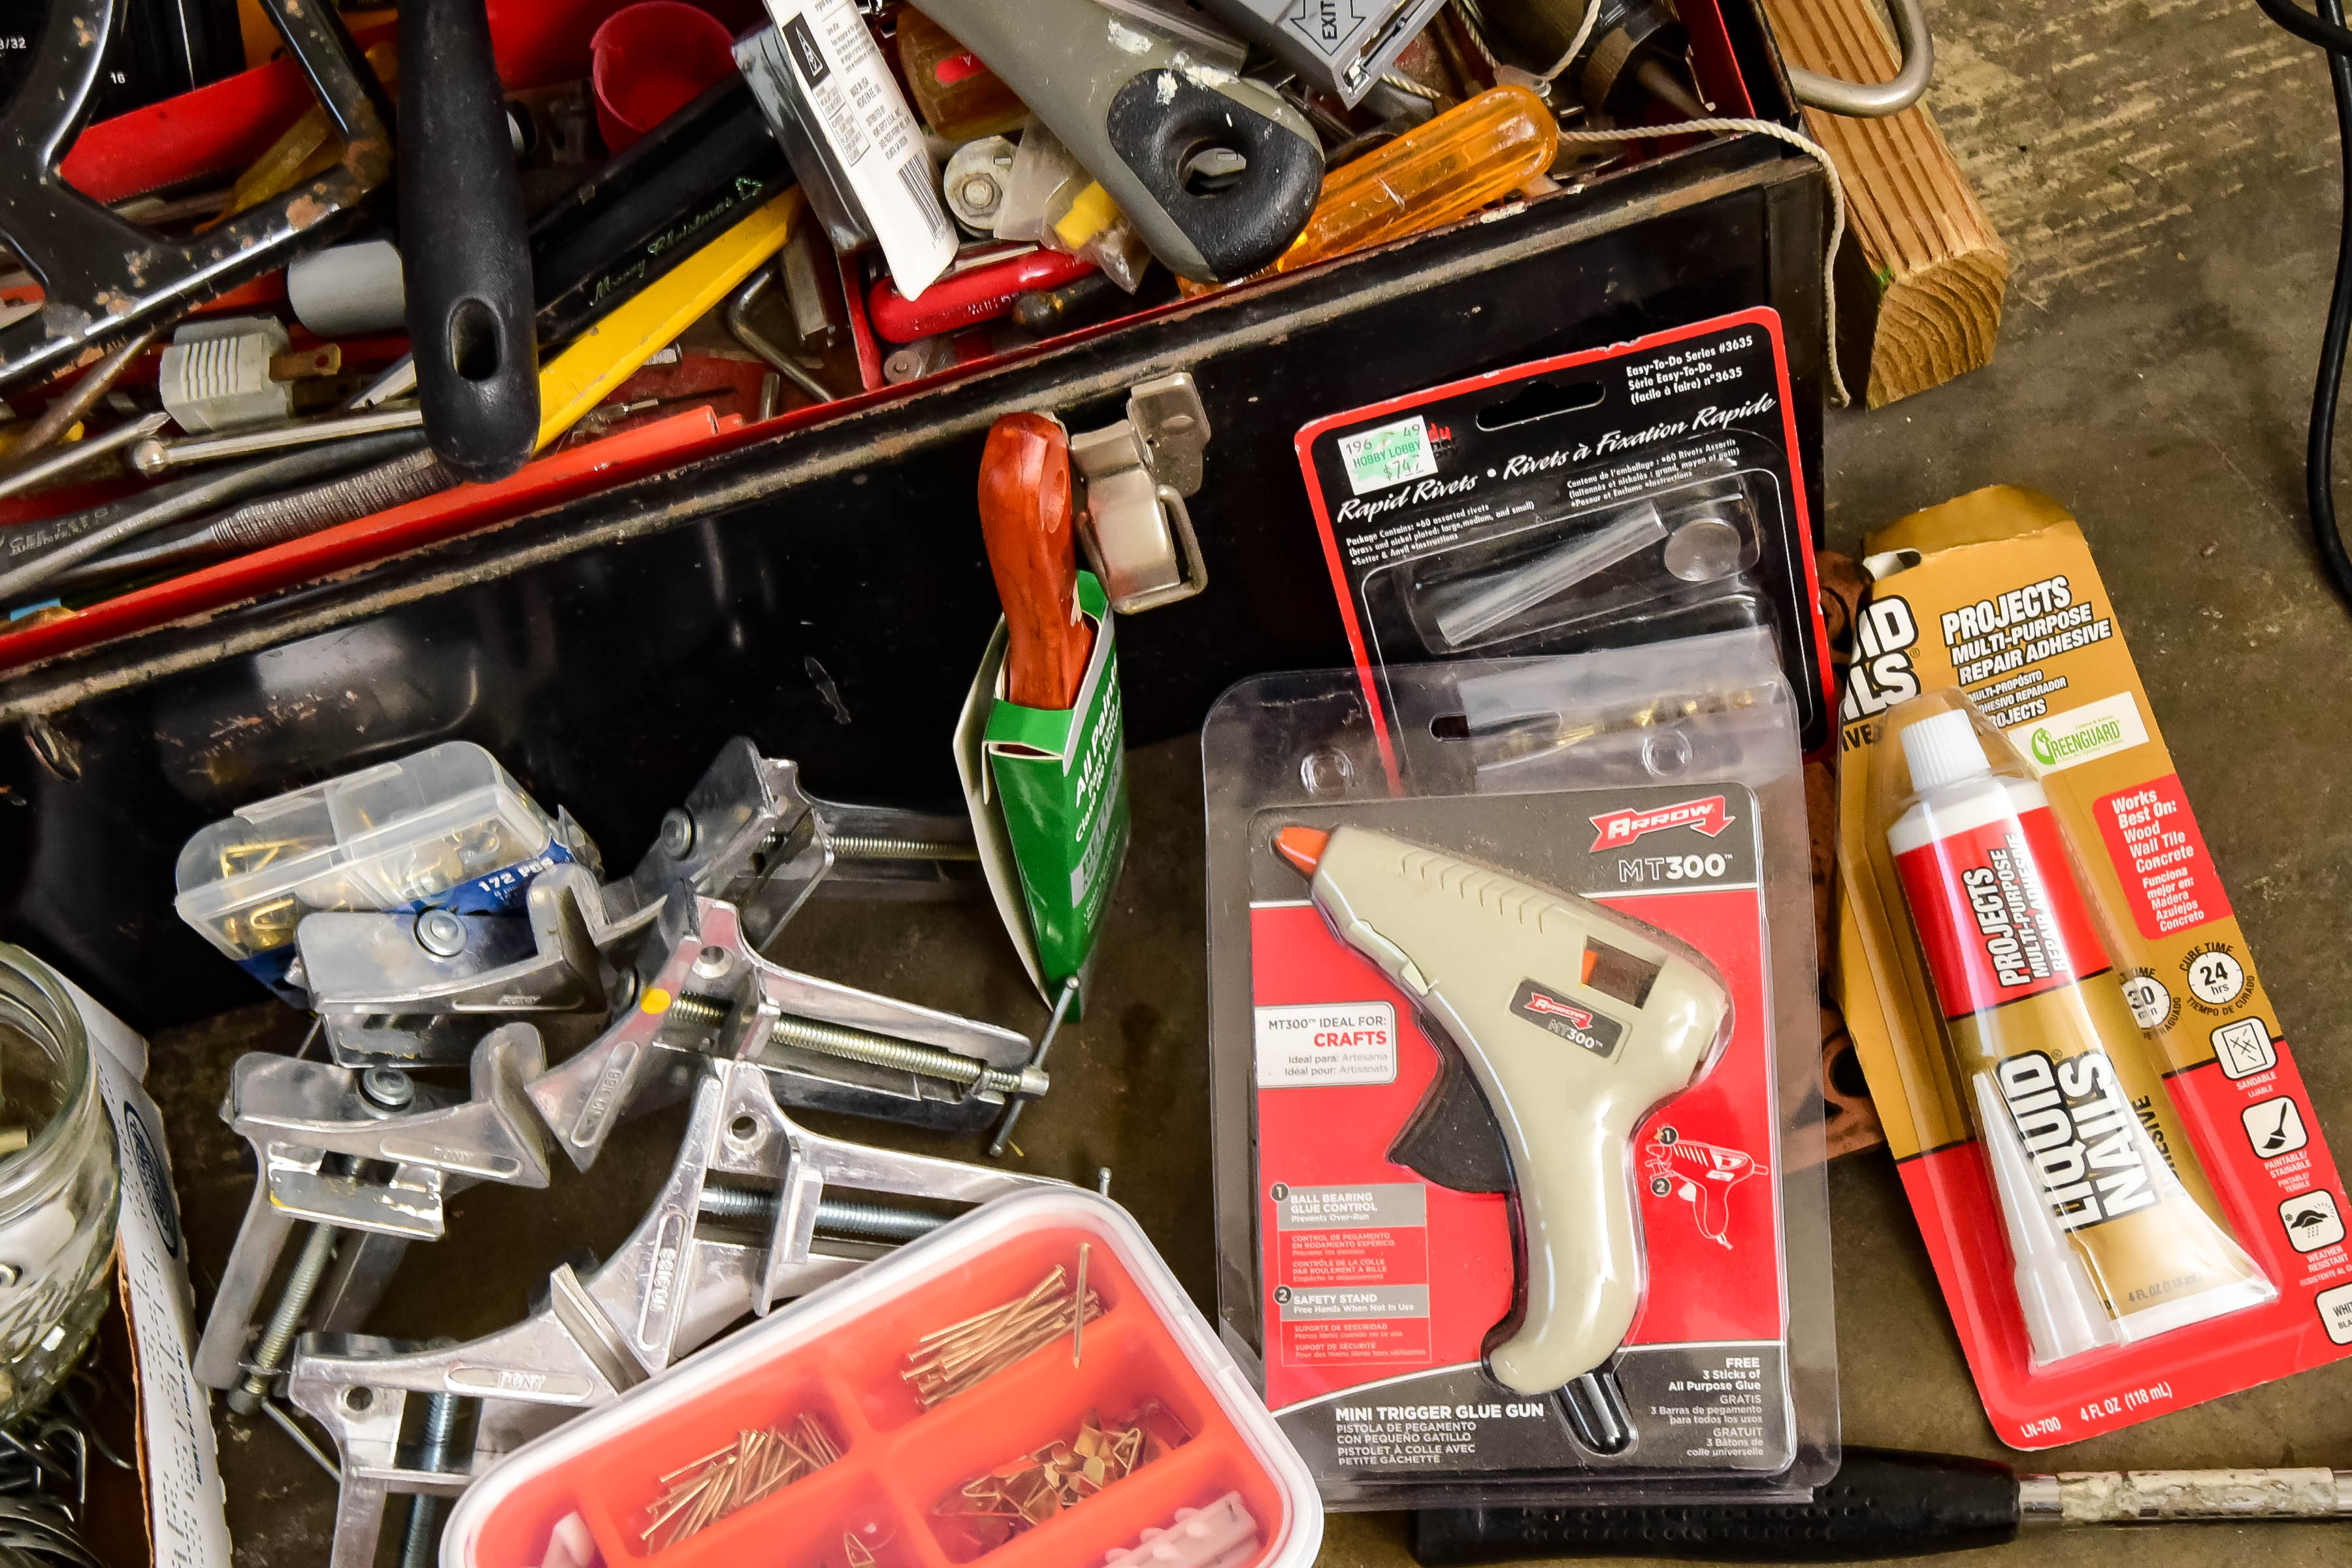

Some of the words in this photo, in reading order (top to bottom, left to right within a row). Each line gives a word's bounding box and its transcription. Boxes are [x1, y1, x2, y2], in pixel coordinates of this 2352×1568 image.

[1320, 1, 1337, 40] EXIT
[1626, 355, 1683, 377] Easy-To-Do
[1686, 346, 1716, 362] Series
[1719, 335, 1753, 354] #3635
[1656, 362, 1712, 384] Easy-To-Do
[1631, 388, 1661, 405] (facile
[1673, 378, 1701, 394] faire)
[1346, 438, 1372, 455] 196
[1353, 450, 1386, 468] HOBBY
[1389, 440, 1420, 458] LOBBY
[1337, 487, 1411, 523] Rapid
[1413, 475, 1478, 504] Rivets
[1503, 449, 1570, 480] Rivets
[1573, 443, 1592, 461] à
[1596, 422, 1688, 455] Fixation
[1692, 393, 1776, 431] Rapide
[1346, 534, 1378, 546] Package
[1433, 510, 1465, 525] assorted
[1467, 504, 1489, 516] rivets
[1349, 545, 1373, 557] (brass
[1375, 542, 1389, 550] and
[1390, 534, 1412, 546] nickel
[1495, 507, 1509, 518] and
[1511, 500, 1535, 514] small)
[1390, 544, 1410, 556] Anvil
[1942, 576, 2071, 645] PROJECTS
[1952, 604, 2091, 666] MULTI-PURPOSE
[1959, 649, 2024, 685] REPAIR
[2027, 619, 2112, 663] ADHESIVE
[2016, 677, 2066, 702] REPARADOR
[2031, 721, 2121, 765] GREENGUARD
[1076, 749, 1092, 809] All
[2112, 790, 2157, 814] Works
[1608, 803, 1716, 840] ARROW
[2118, 808, 2151, 829] Best
[2153, 801, 2177, 819] On:
[2123, 821, 2160, 843] Wood
[2130, 838, 2159, 858] Wall
[2161, 830, 2185, 849] Tile
[2136, 845, 2194, 873] Concrete
[478, 872, 516, 892] 172
[2142, 866, 2187, 889] Funciona
[2147, 881, 2176, 900] mejor
[2178, 877, 2194, 890] en:
[2151, 890, 2189, 910] Madera
[2156, 900, 2198, 921] Azulejos
[1990, 849, 2051, 978] MULTI-PURPOSE
[2159, 910, 2204, 932] Concreto
[1963, 867, 2032, 987] PROJECTS
[2180, 945, 2202, 972] CURE
[2204, 941, 2234, 955] TIME
[2200, 961, 2228, 986] 24
[2187, 996, 2219, 1017] TIEMPO
[2236, 975, 2255, 1009] CURADO
[2212, 983, 2230, 996] hrs
[1320, 1017, 1355, 1028] IDEAL
[1359, 1016, 1386, 1026] FOR:
[1314, 1030, 1386, 1047] CRAFTS
[1288, 1055, 1311, 1064] Ideal
[1315, 1056, 1339, 1066] para:
[1284, 1067, 1308, 1077] Idéal
[1311, 1068, 1336, 1077] pour:
[2236, 1071, 2277, 1090] SANDABLE
[2000, 1053, 2103, 1232] LIQUID
[2057, 1052, 2157, 1218] NAILS
[2263, 1150, 2308, 1171] PAINTABLE/
[2270, 1160, 2312, 1179] STAINABLE
[1656, 1181, 1665, 1192] 2
[1290, 1195, 1320, 1204] BALL
[1322, 1192, 1373, 1203] BEARING
[1291, 1204, 1320, 1214] GLUE
[1323, 1202, 1377, 1213] CONTROL
[2306, 1245, 2344, 1263] WEATHER
[2308, 1253, 2349, 1273] RESISTANT
[1279, 1290, 1288, 1301] 2
[1294, 1296, 1336, 1305] SAFETY
[1340, 1294, 1377, 1303] STAND
[1725, 1358, 1759, 1368] FREE
[1703, 1371, 1710, 1379] 3
[1713, 1370, 1745, 1379] Sticks
[1748, 1369, 1760, 1379] of
[1669, 1382, 1684, 1391] All
[1687, 1382, 1733, 1392] Purpose
[1735, 1380, 1761, 1390] Glue
[1720, 1394, 1761, 1403] GRATIS
[1336, 1407, 1372, 1422] MINI
[1377, 1406, 1451, 1420] TRIGGER
[1455, 1405, 1502, 1418] GLUE
[1505, 1403, 1544, 1418] GUN
[1659, 1406, 1690, 1414] Barras
[1692, 1405, 1704, 1414] de
[1707, 1407, 1762, 1416] pegamento
[1669, 1416, 1691, 1426] para
[1693, 1415, 1721, 1424] todos
[1724, 1414, 1738, 1423] los
[2020, 1416, 2061, 1438] LN-700
[2080, 1407, 2089, 1422] 4
[2089, 1404, 2105, 1419] FL
[2104, 1397, 2122, 1414] OZ
[2125, 1388, 2149, 1411] (118
[2149, 1381, 2173, 1399] mL)
[1337, 1424, 1383, 1433] PISTOLA
[1386, 1423, 1402, 1432] DE
[1405, 1422, 1477, 1432] PEGAMENTO
[1337, 1435, 1362, 1445] CON
[1365, 1431, 1420, 1444] PEQUEÑO
[1423, 1432, 1471, 1443] GATILLO
[1714, 1428, 1762, 1437] GRATUIT
[1338, 1446, 1390, 1456] PISTOLET
[1394, 1443, 1402, 1454] À
[1406, 1445, 1441, 1454] COLLE
[1446, 1443, 1476, 1454] AVEC
[1713, 1448, 1763, 1456] universelle
[1339, 1457, 1377, 1465] PETITE
